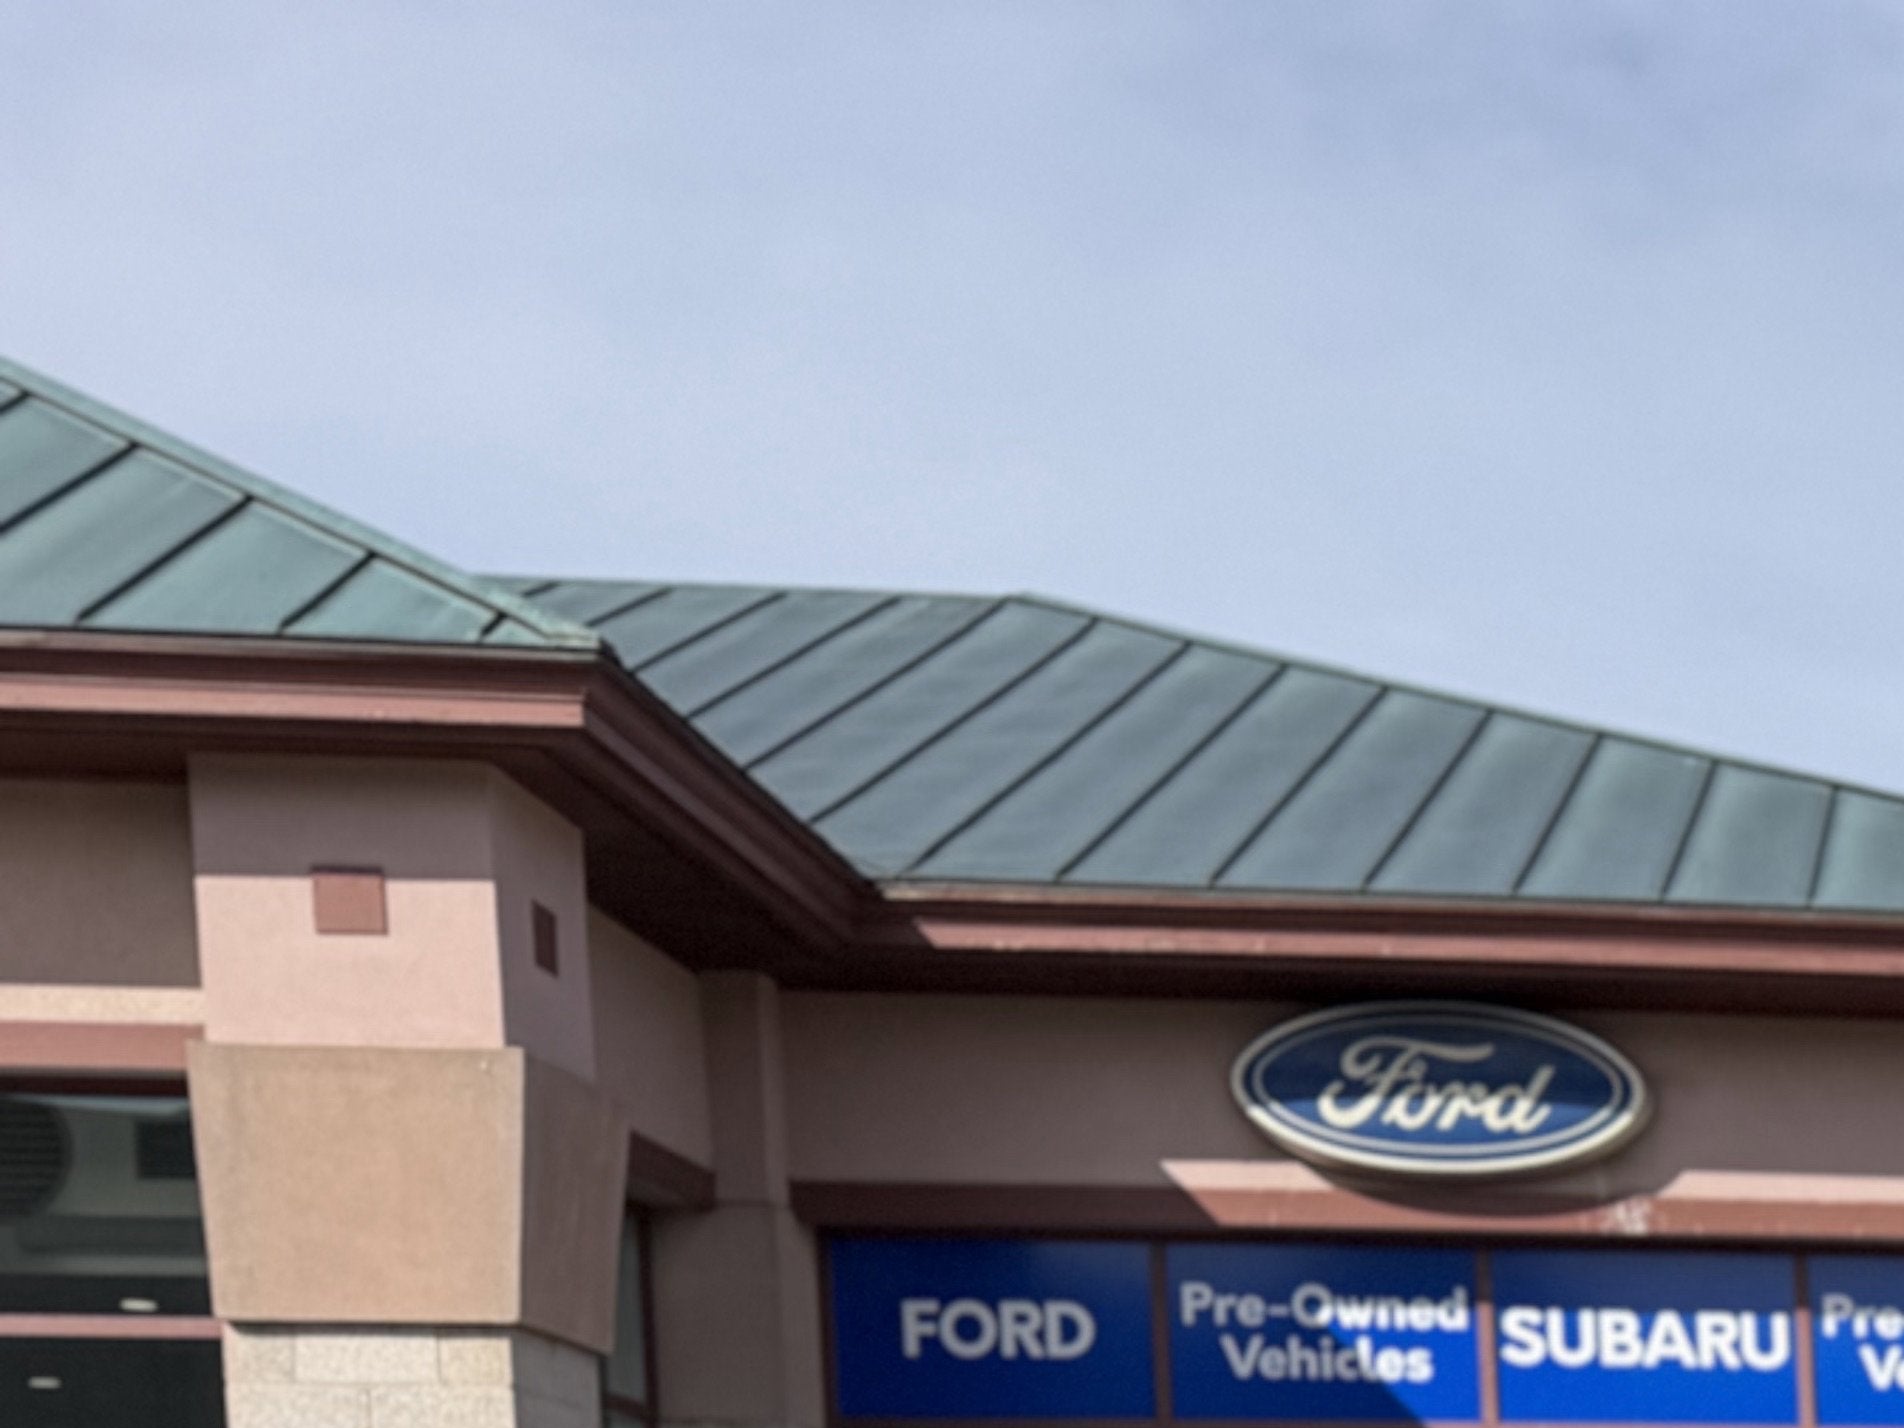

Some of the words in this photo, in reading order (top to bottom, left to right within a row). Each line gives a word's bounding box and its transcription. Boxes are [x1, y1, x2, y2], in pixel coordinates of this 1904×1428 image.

[1318, 1036, 1554, 1132] Ford
[900, 1299, 1097, 1360] FORD
[1181, 1281, 1468, 1330] Pre-Owned
[1222, 1334, 1434, 1383] Vehicles
[1500, 1307, 1790, 1371] SUBARU
